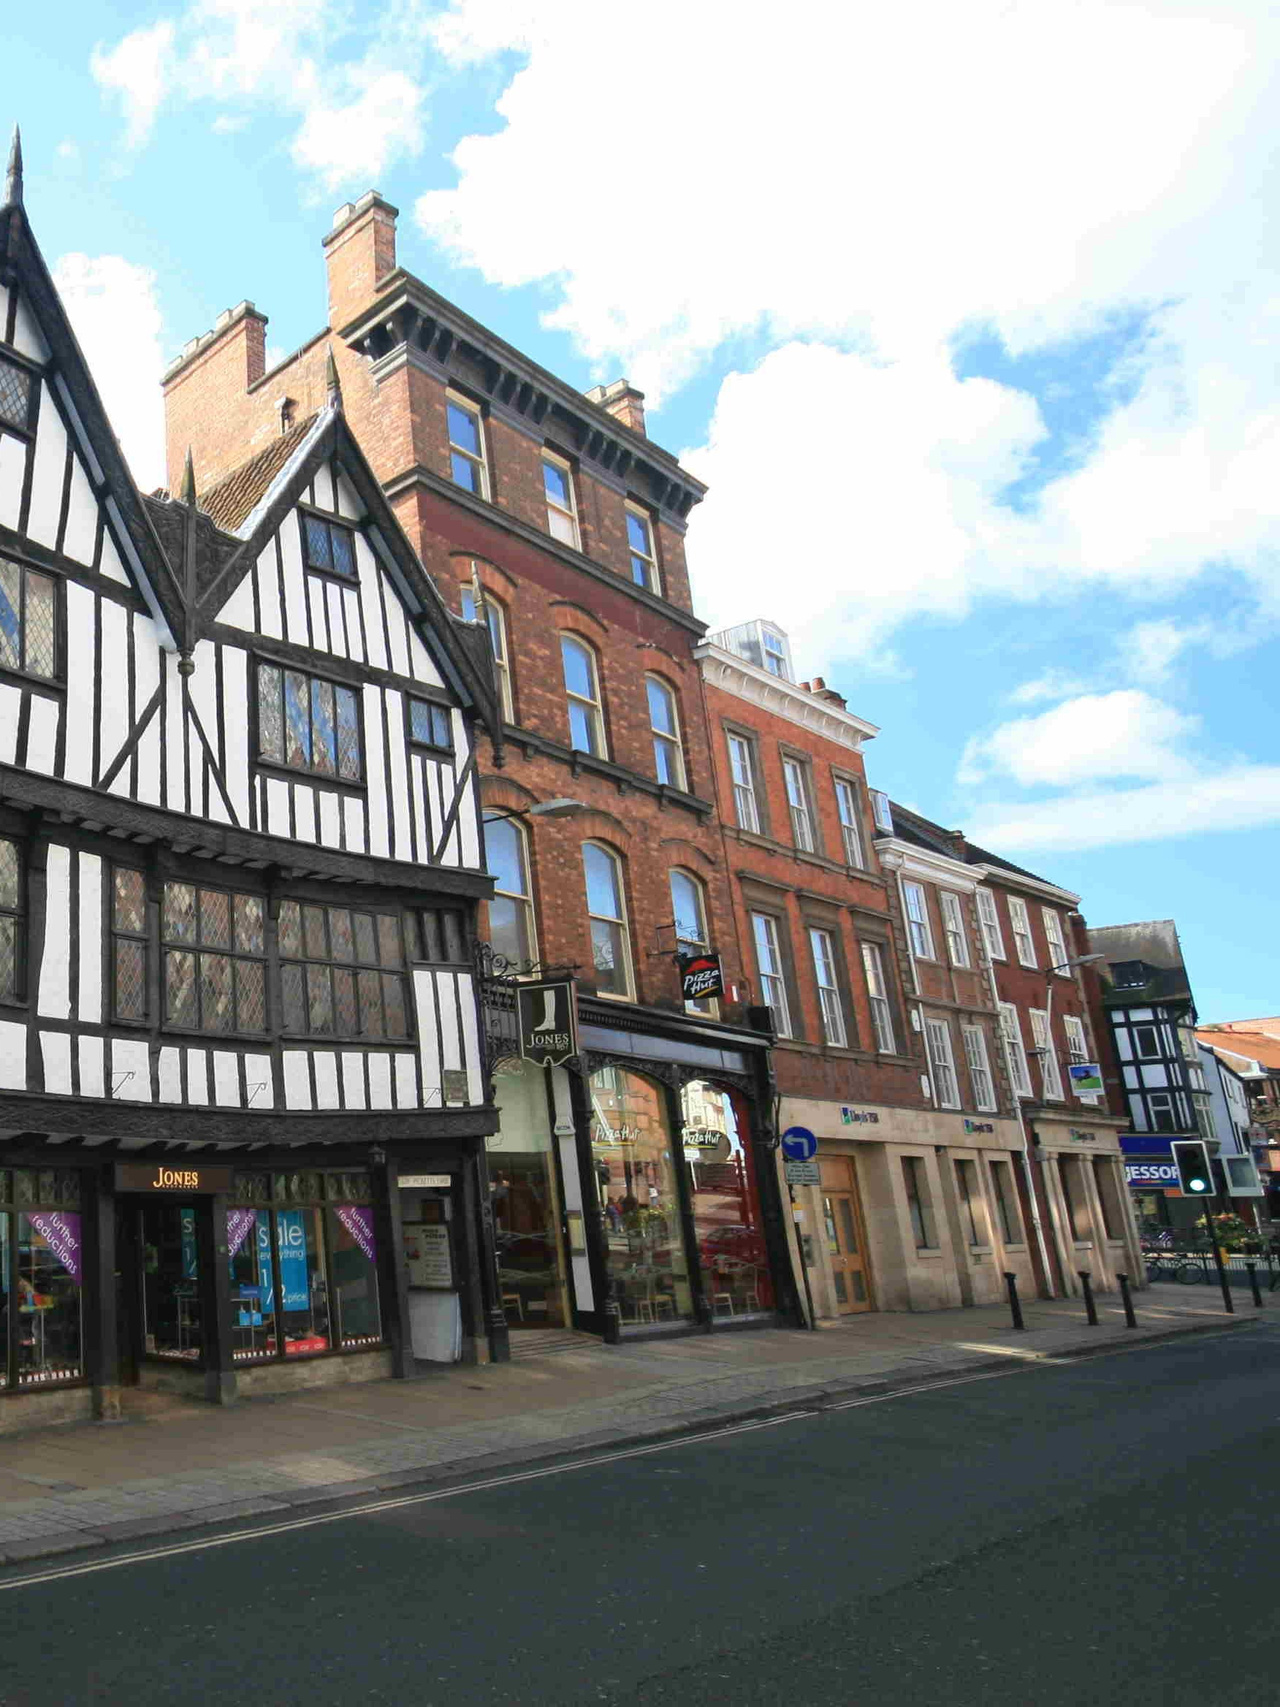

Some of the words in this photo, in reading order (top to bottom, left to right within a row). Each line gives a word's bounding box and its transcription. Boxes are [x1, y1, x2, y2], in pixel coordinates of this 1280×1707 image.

[684, 969, 720, 992] Pizza
[690, 978, 716, 995] Hut
[526, 1033, 569, 1049] JONES
[595, 1124, 621, 1141] Pizza
[621, 1123, 641, 1140] Hut
[682, 1129, 704, 1144] Pizza
[705, 1131, 722, 1144] Hut
[152, 1167, 199, 1187] JONES
[338, 1210, 373, 1259] reductions
[32, 1215, 78, 1275] reductions
